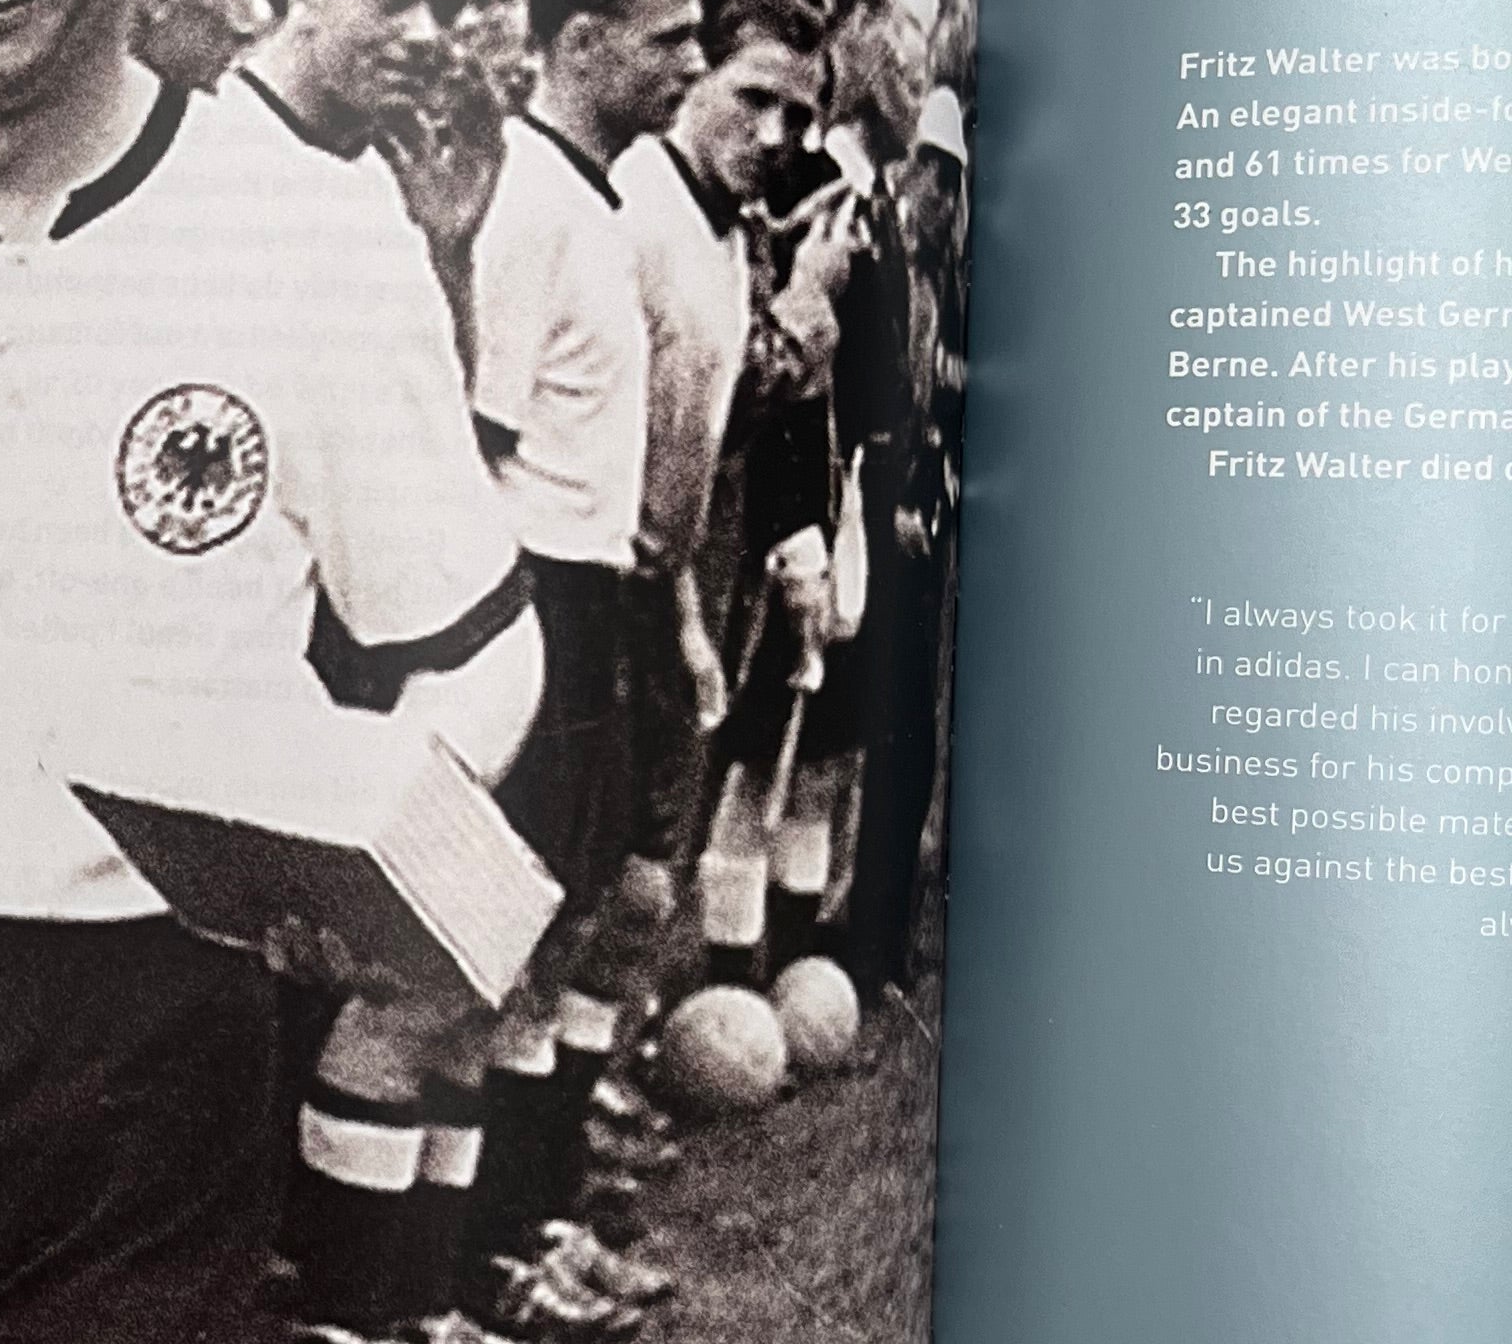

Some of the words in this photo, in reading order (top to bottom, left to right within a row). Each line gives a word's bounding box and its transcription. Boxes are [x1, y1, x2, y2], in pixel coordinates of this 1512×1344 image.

[1181, 50, 1256, 79] Fritz
[1266, 47, 1381, 76] Walter
[1392, 51, 1460, 71] was
[1472, 44, 1512, 71] bo
[1176, 102, 1220, 130] An
[1230, 99, 1358, 133] elegant
[1175, 150, 1235, 180] and
[1244, 149, 1280, 177] 61
[1294, 148, 1390, 176] times
[1402, 147, 1450, 174] for
[1462, 147, 1512, 173] We
[1173, 201, 1211, 229] 33
[1220, 199, 1321, 235] goals.
[1216, 250, 1277, 278] The
[1288, 248, 1441, 283] highlight
[1451, 249, 1484, 276] of
[1169, 299, 1332, 335] captained
[1343, 300, 1427, 327] West
[1168, 350, 1278, 378] Berne.
[1287, 350, 1377, 378] After
[1388, 350, 1437, 378] his
[1166, 400, 1286, 434] captain
[1296, 400, 1330, 428] of
[1339, 401, 1393, 429] the
[1404, 402, 1512, 430] Germa
[1208, 449, 1286, 478] Fritz
[1295, 451, 1412, 480] Walter
[1421, 453, 1493, 481] died
[1223, 599, 1334, 636] always
[1347, 604, 1416, 631] took
[1429, 604, 1448, 633] it
[1462, 605, 1507, 634] for
[1196, 647, 1223, 676] in
[1234, 650, 1350, 681] adidas.
[1364, 653, 1370, 681] I
[1383, 662, 1440, 682] can
[1453, 657, 1512, 685] hon
[1212, 702, 1358, 734] regarded
[1371, 703, 1418, 733] his
[1156, 743, 1298, 778] business
[1310, 751, 1356, 780] for
[1367, 754, 1414, 783] his
[1426, 764, 1512, 793] comp
[1211, 795, 1280, 827] best
[1291, 803, 1426, 835] possible
[1207, 852, 1244, 874] us
[1254, 851, 1374, 885] against
[1386, 855, 1437, 884] the
[1480, 910, 1512, 937] al
